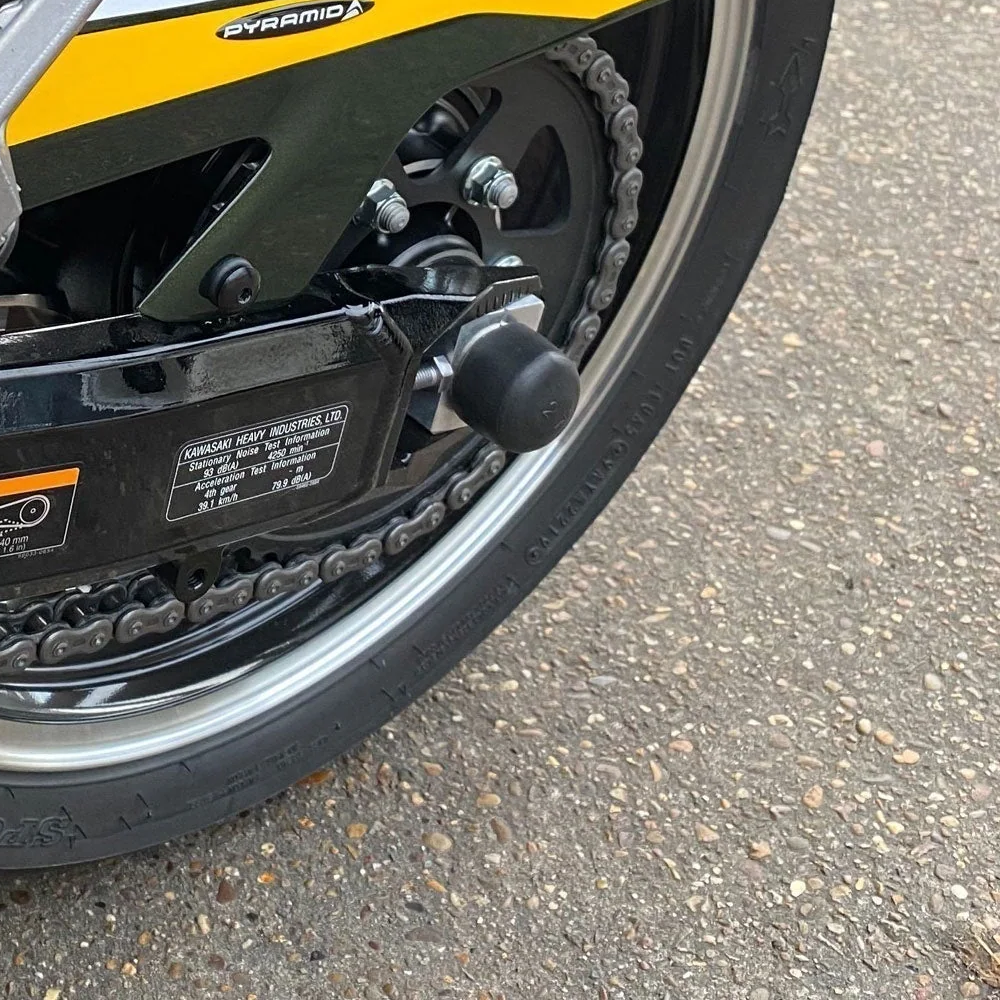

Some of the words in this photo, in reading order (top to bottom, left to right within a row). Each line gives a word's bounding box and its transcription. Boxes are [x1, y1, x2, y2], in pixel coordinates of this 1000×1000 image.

[222, 3, 344, 39] PYRAMID
[184, 438, 232, 460] KAWASAKI
[236, 429, 266, 449] HEAVY
[269, 415, 323, 438] INDUSTRIES,
[325, 409, 343, 424] LTD.
[189, 453, 232, 472] Stationary
[236, 447, 260, 460] Noise
[264, 441, 281, 452] Test
[285, 427, 330, 446] Information
[203, 467, 214, 478] 93
[217, 460, 240, 475] dB(A)
[268, 449, 287, 461] 4250
[194, 470, 246, 491] Acceleration
[250, 465, 268, 477] Test
[271, 451, 317, 471] Information
[271, 478, 289, 491] 79.9
[290, 471, 312, 485] dB(A)
[197, 500, 215, 512] 39.1
[218, 493, 239, 506] km/h
[204, 488, 217, 499] 4th
[220, 482, 238, 498] gear
[0, 536, 11, 547] 40
[12, 535, 29, 545] mm
